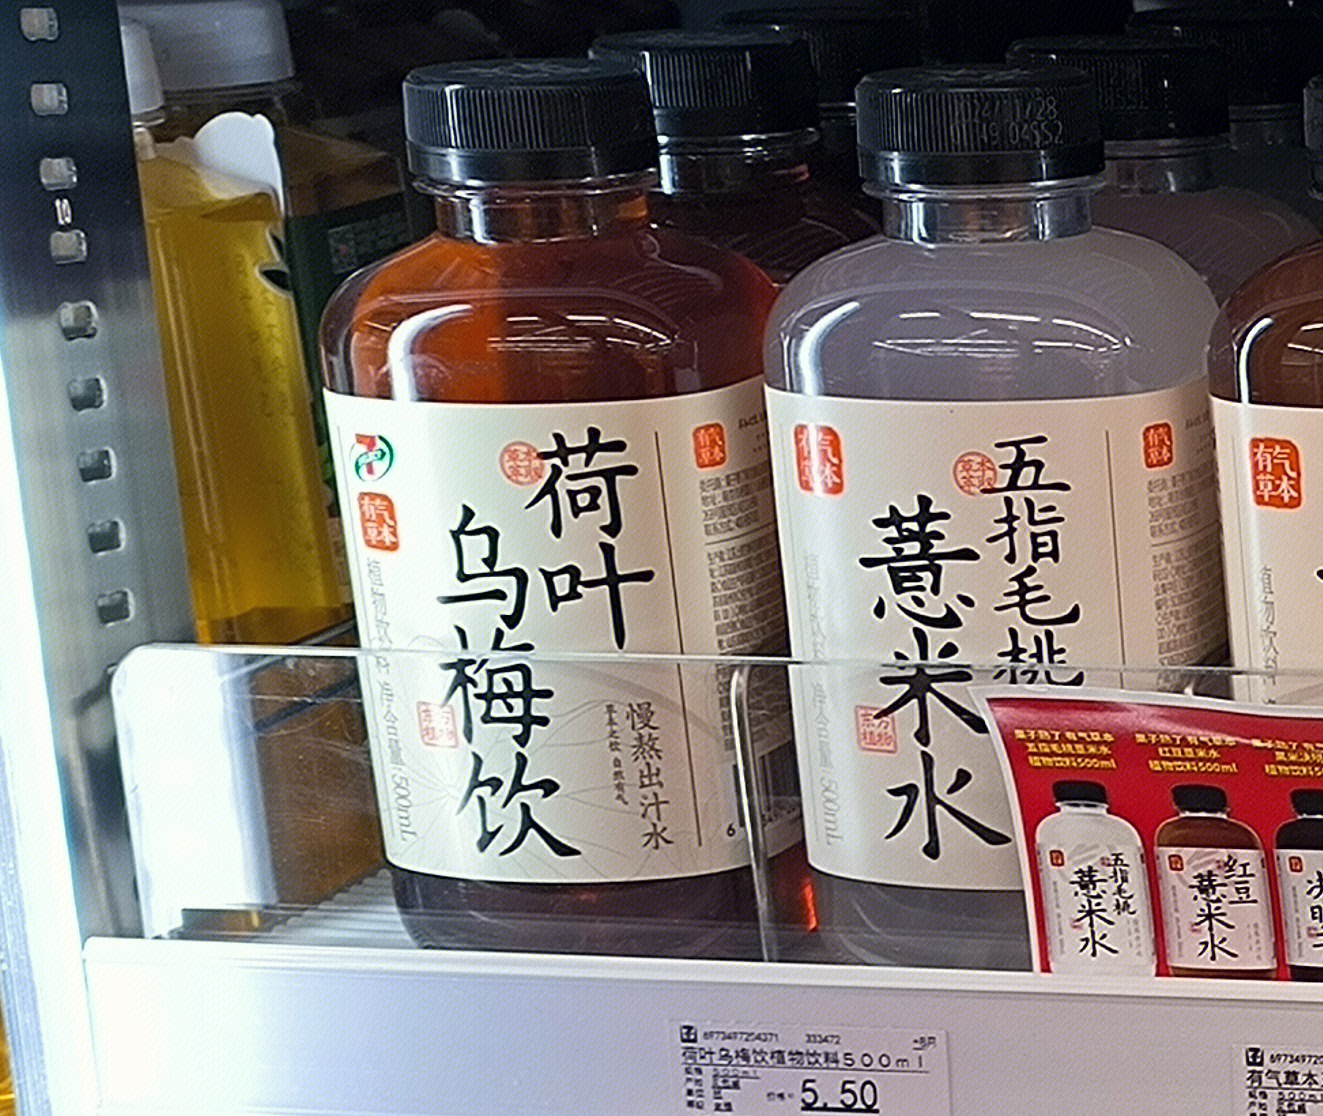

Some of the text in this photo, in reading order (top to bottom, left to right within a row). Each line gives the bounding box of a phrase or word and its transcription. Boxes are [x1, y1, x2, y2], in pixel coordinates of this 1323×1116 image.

[524, 427, 655, 649] 荷叶
[981, 436, 1085, 686] 五指毛桃
[436, 504, 582, 857] 乌梅饮
[859, 495, 1012, 861] 薏米水
[627, 702, 673, 850] 慢熬出汁水
[1069, 865, 1119, 957] 薏米水
[1188, 872, 1239, 962] 薏米水
[1224, 854, 1259, 906] 红豆
[801, 1079, 879, 1109] 5.50
